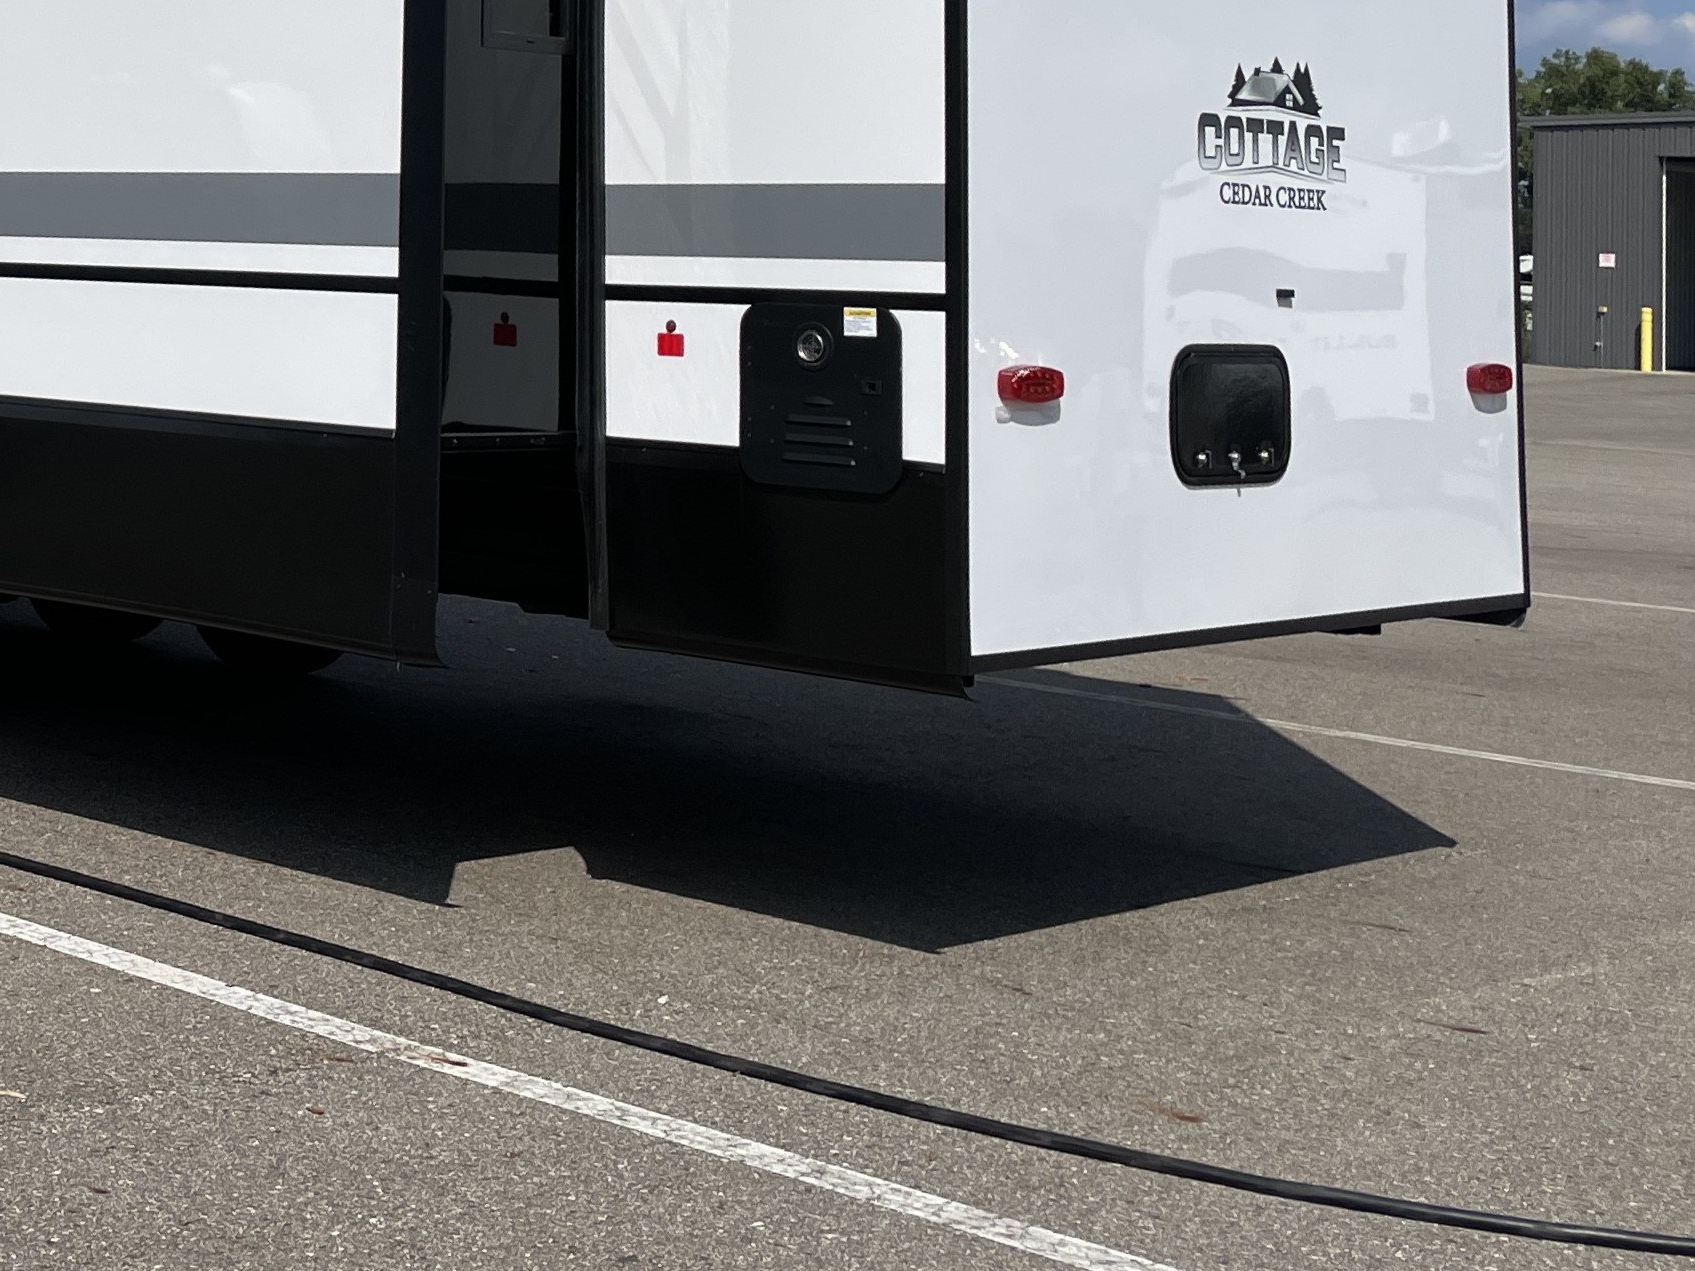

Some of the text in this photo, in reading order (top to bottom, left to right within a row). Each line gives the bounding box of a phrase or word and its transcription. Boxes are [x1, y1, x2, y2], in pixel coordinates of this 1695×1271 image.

[1198, 113, 1346, 183] COTTAGE
[1220, 182, 1327, 210] CEDAR CREEK
